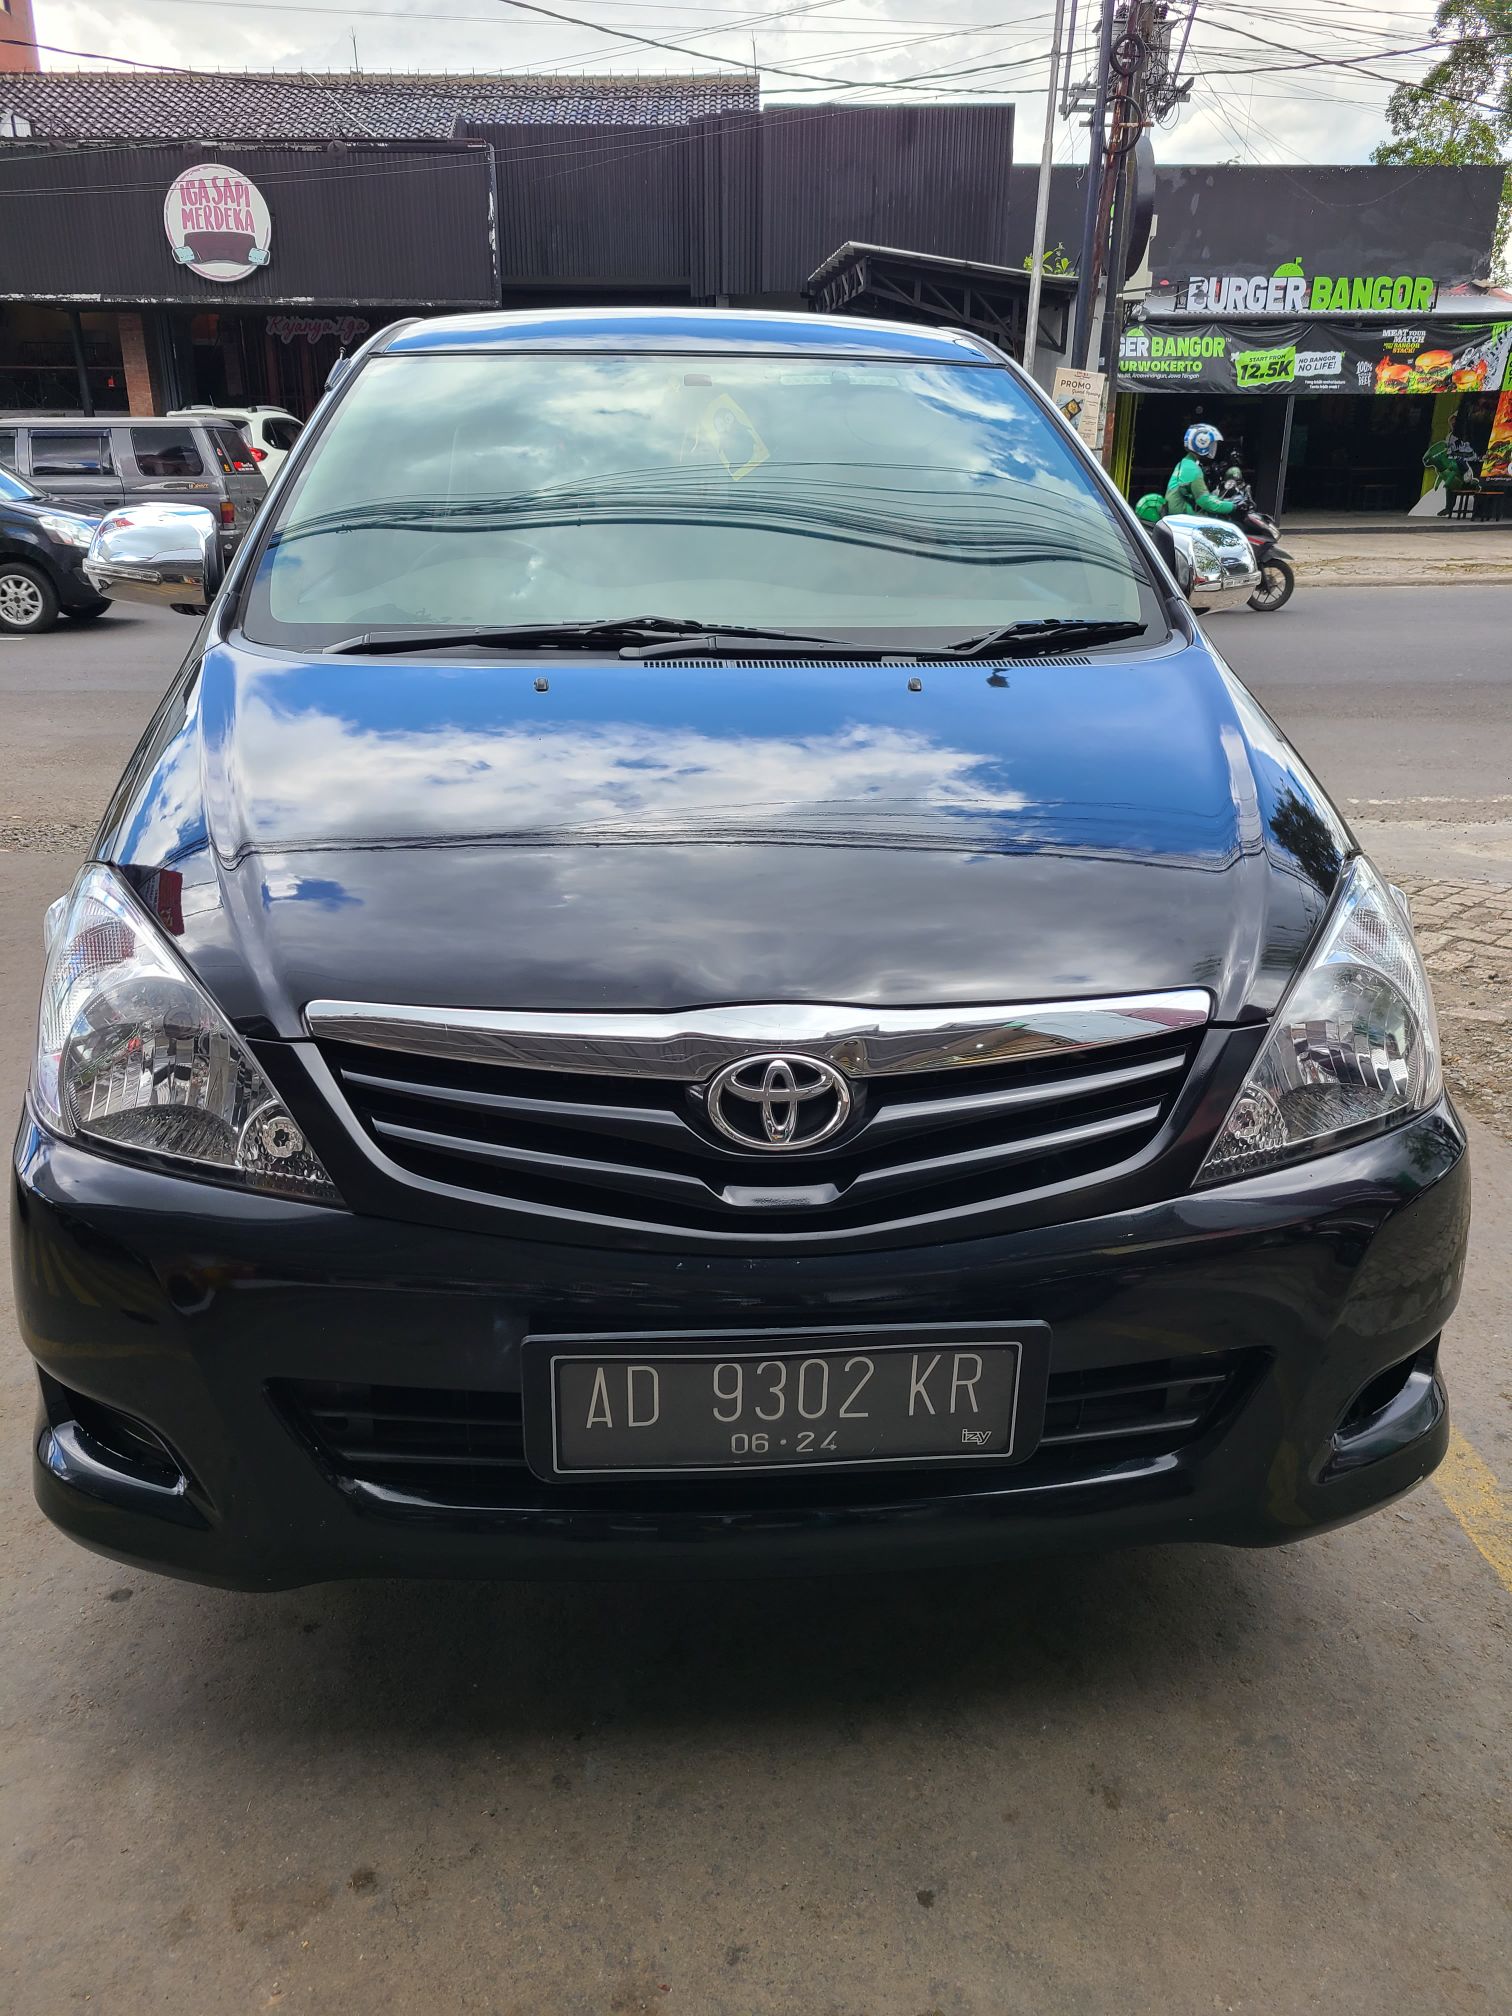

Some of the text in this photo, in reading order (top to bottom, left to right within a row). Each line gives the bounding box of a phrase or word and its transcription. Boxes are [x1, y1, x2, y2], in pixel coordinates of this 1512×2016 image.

[180, 179, 210, 206] IGA
[181, 205, 255, 233] MERDEKA
[1187, 276, 1434, 312] BURGER BANGOR
[1382, 329, 1409, 337] MEAT
[1393, 335, 1425, 343] MATCH
[1151, 336, 1225, 358] BANGOR
[1118, 360, 1203, 373] URWOKERTO
[1240, 359, 1294, 381] 12.5K
[1297, 361, 1337, 372] NO LIFE!
[1060, 379, 1091, 390] PROMO
[585, 1352, 985, 1430] AD 9302 KR
[961, 1426, 992, 1446] izy
